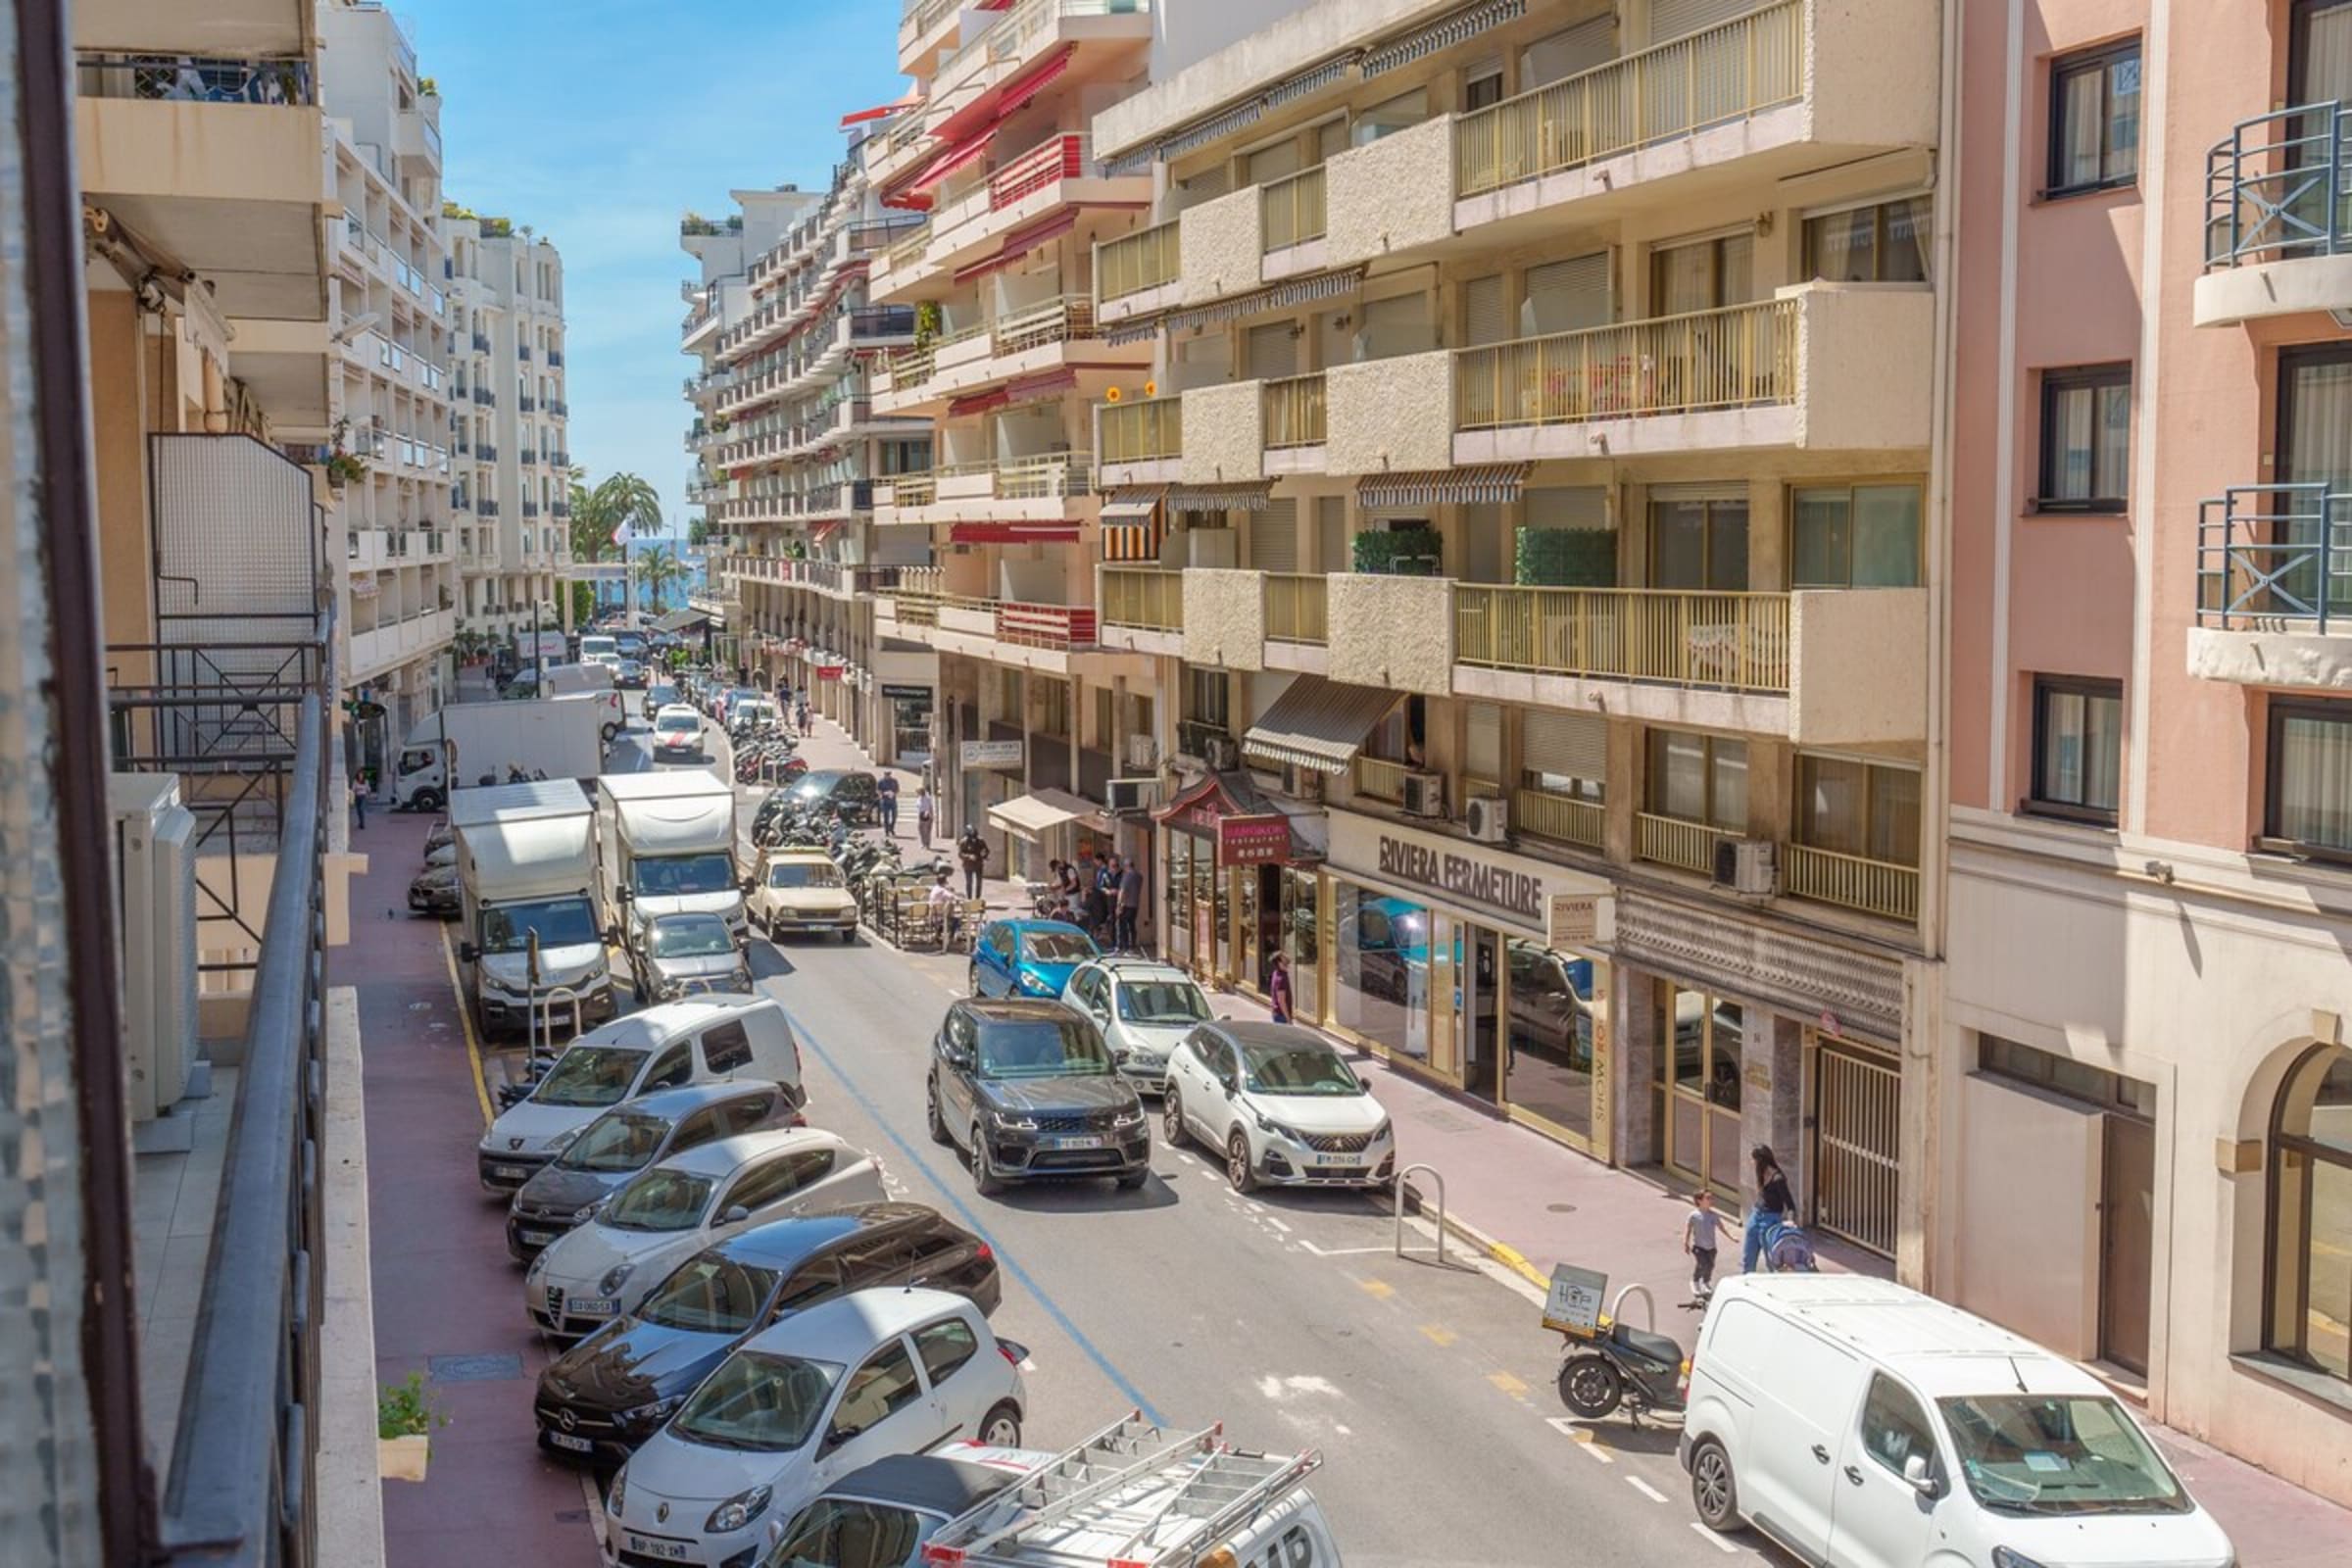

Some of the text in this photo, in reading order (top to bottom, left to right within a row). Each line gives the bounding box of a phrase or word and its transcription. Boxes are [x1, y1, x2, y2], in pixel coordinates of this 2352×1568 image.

[1379, 835, 1543, 920] RIVIERA FERMETURE
[1553, 902, 1593, 911] RIVIERA
[1594, 989, 1606, 1122] SHOW ROM
